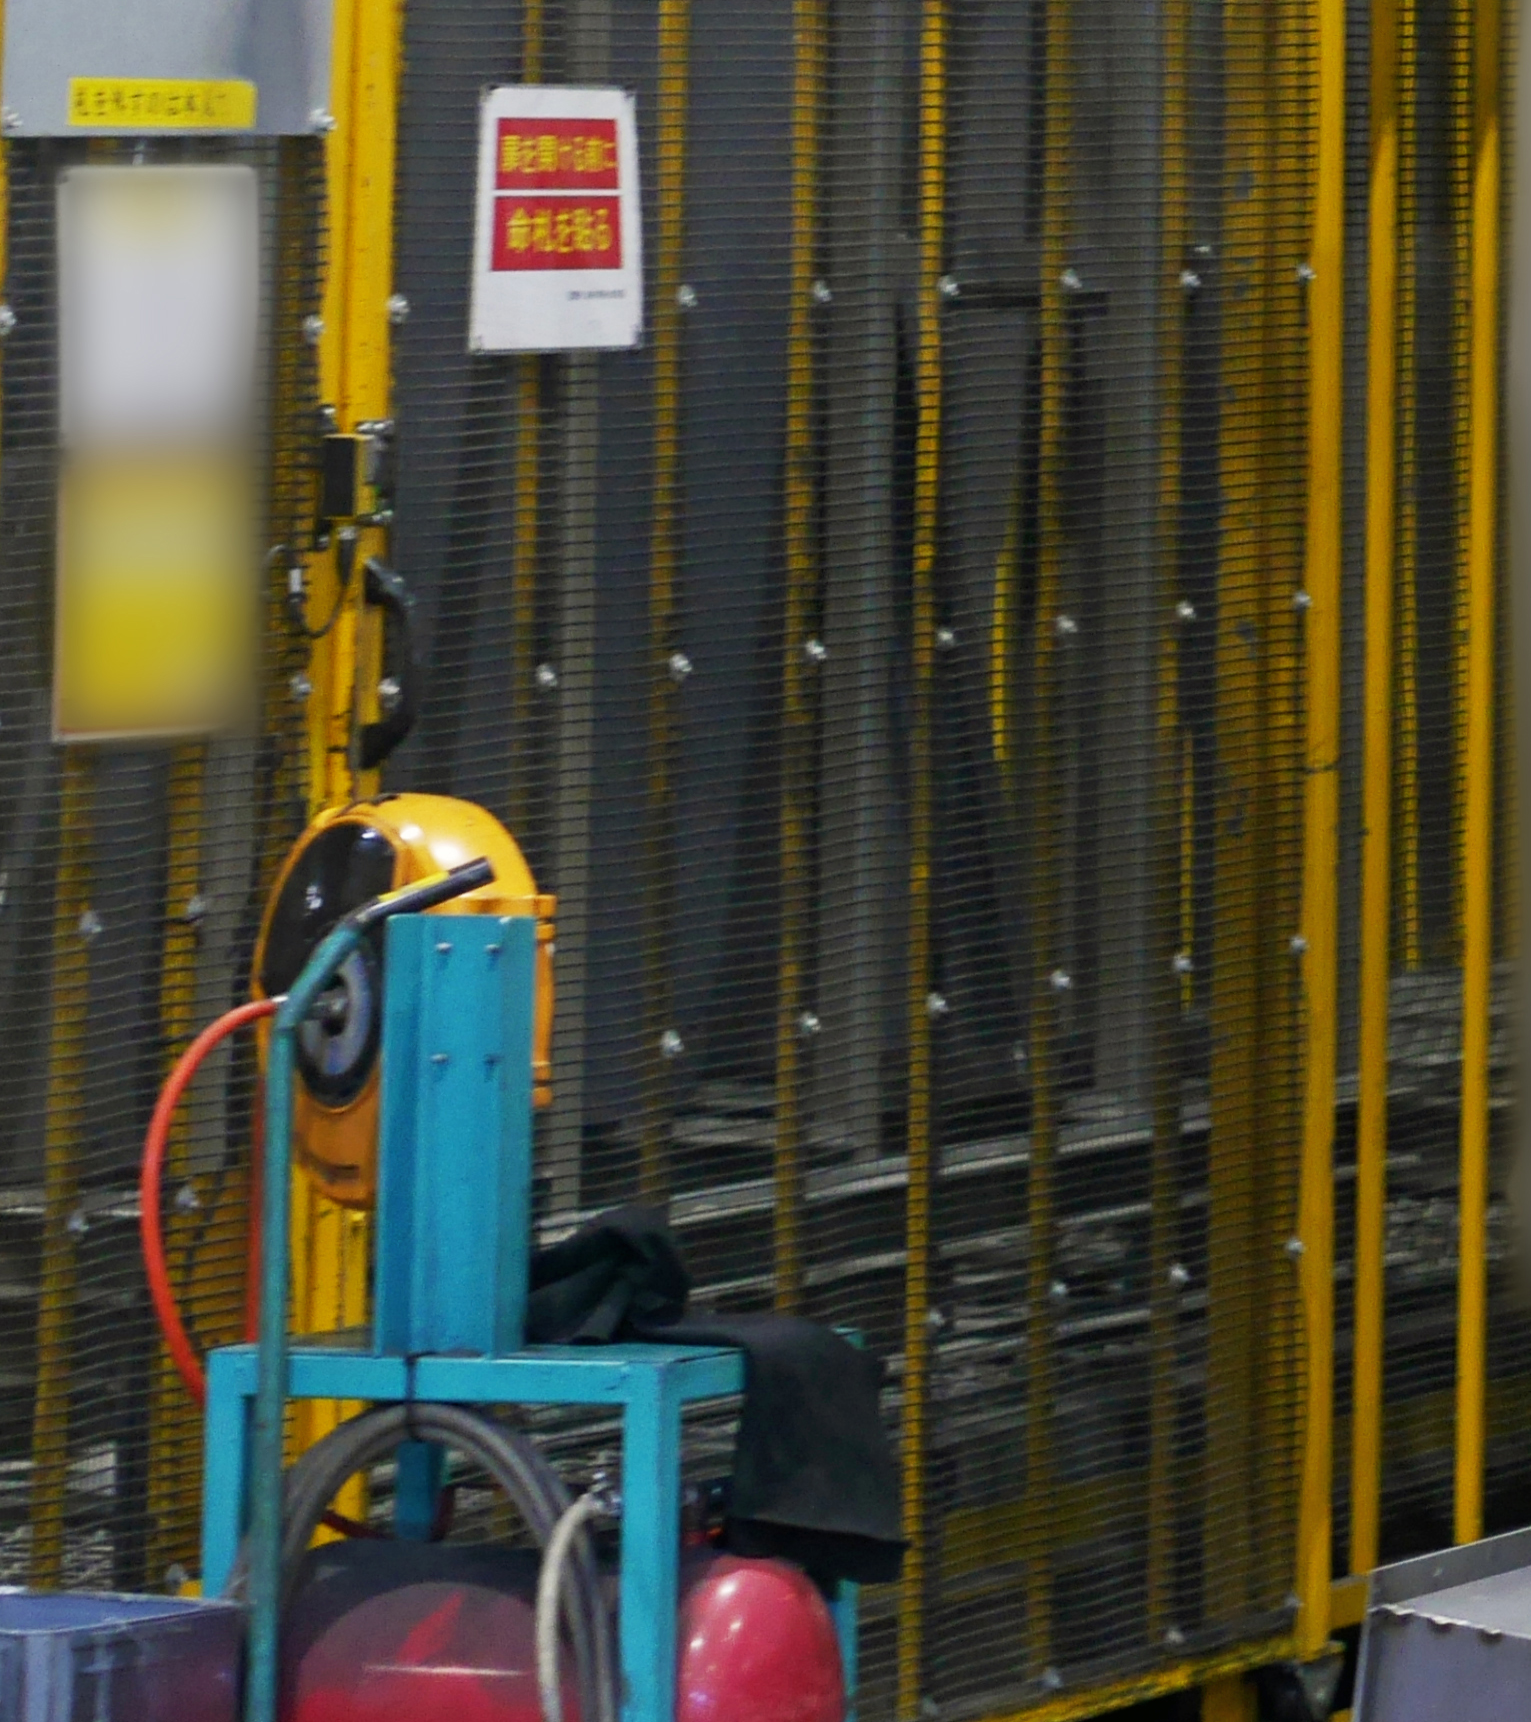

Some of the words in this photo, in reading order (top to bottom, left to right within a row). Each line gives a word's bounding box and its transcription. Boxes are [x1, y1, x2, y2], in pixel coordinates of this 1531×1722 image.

[502, 134, 617, 173] 扉を開ける前に
